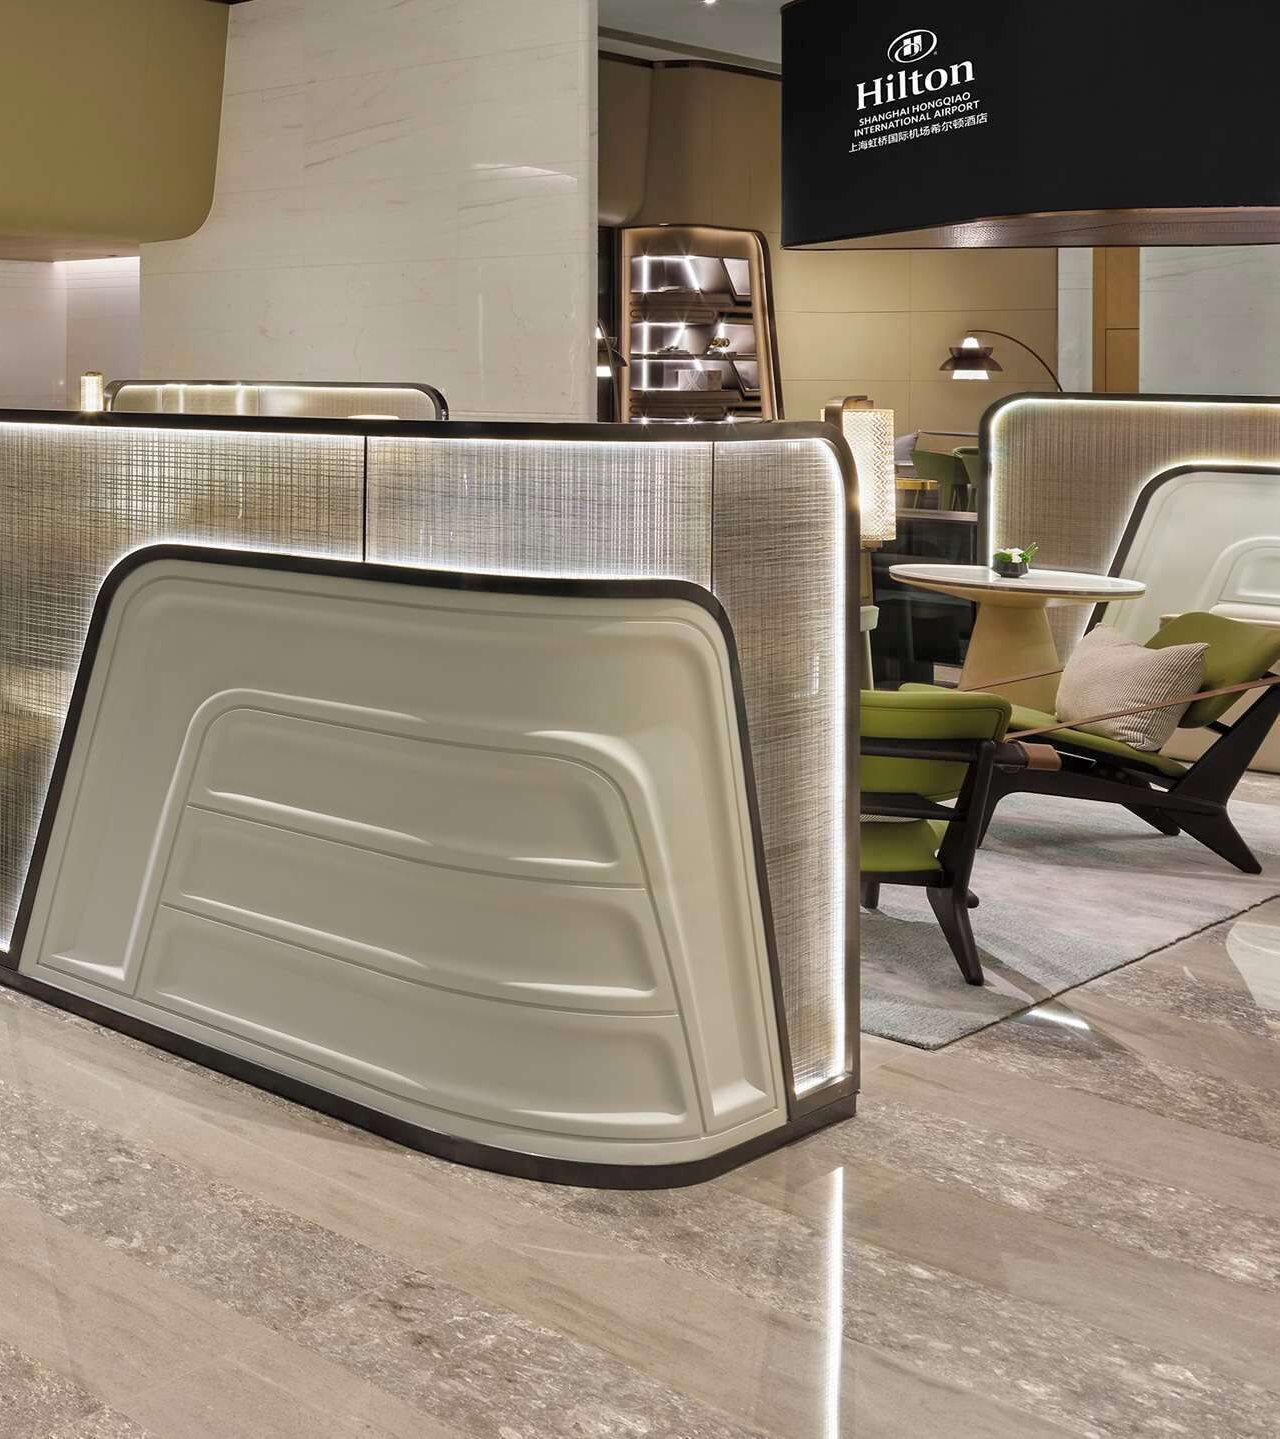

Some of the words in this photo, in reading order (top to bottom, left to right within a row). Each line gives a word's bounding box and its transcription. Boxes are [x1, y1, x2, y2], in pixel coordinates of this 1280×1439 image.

[856, 60, 976, 110] Hilton
[854, 112, 932, 137] INTERNATIONAL
[934, 100, 980, 118] AIRPORT
[859, 107, 910, 126] SHANGHAI
[912, 91, 971, 114] HONGQIAO
[848, 112, 989, 153] 上海虹桥国际机场希尔顿酒店
